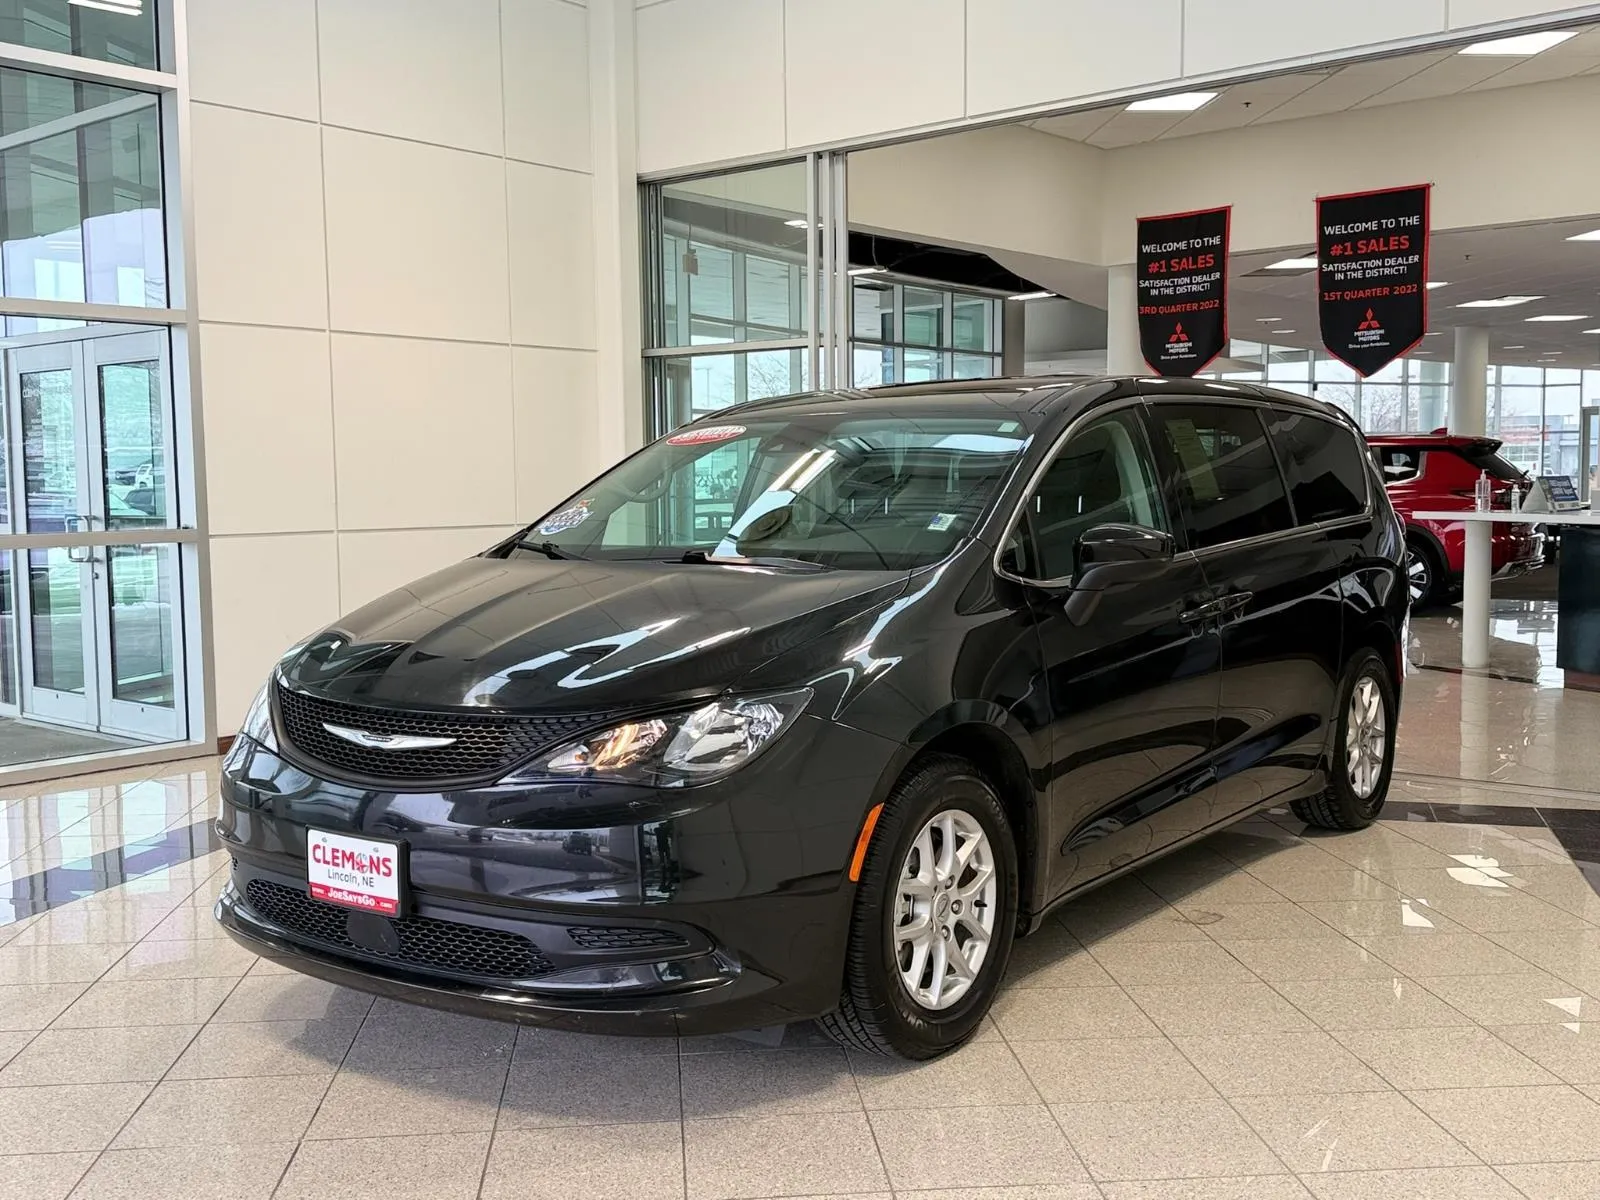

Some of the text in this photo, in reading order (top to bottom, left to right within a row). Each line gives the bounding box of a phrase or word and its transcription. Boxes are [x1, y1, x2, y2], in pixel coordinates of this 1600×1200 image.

[1324, 215, 1420, 235] WELCOME TO THE
[1142, 235, 1221, 253] WELCOME TO THE
[1330, 235, 1410, 256] #1 SALES
[1147, 254, 1215, 273] #1 SALES
[1322, 255, 1420, 272] SATISFACTION DEALER
[1138, 272, 1221, 288] SATISFACTION DEALER
[1334, 266, 1407, 280] IN THE DISTRICT!
[1150, 282, 1210, 296] IN THE DISTRICT!
[1323, 284, 1418, 301] 1ST QUARTER 2022
[1139, 300, 1220, 315] 3RD QUARTER 2022
[312, 844, 392, 877] CLEMONS
[328, 869, 375, 888] Lincoln, NE
